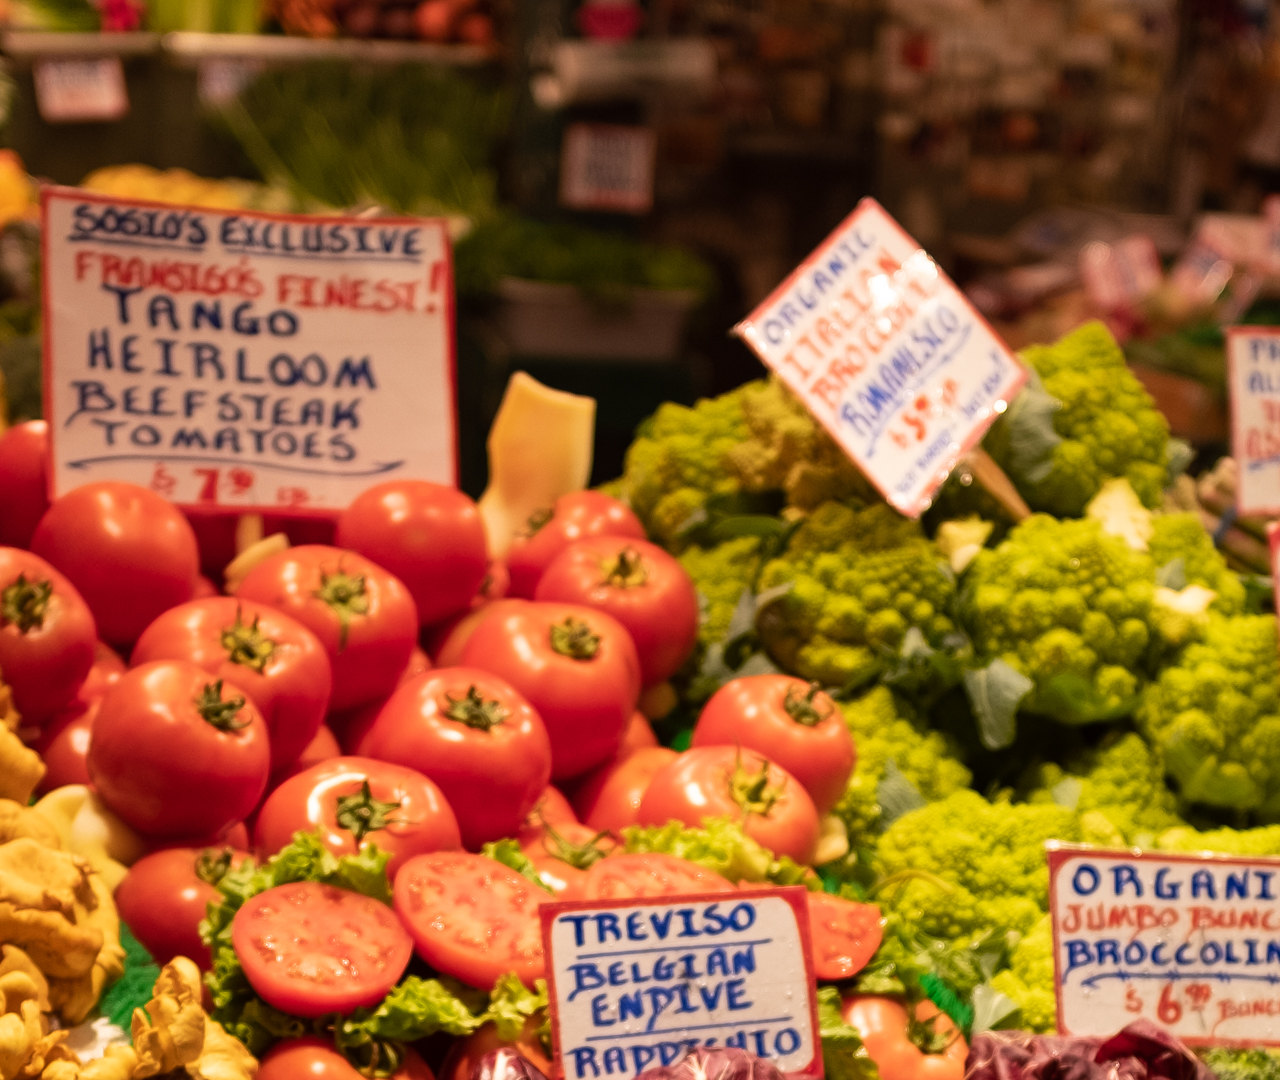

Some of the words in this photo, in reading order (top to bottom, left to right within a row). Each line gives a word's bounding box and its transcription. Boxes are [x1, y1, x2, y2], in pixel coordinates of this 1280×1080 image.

[220, 216, 424, 257] EXCLUSIVE
[100, 283, 300, 337] TANGO
[276, 259, 449, 317] FINEST!
[87, 328, 377, 389] HEIRLOOM
[64, 380, 361, 430] BEEFSTEAK
[92, 417, 358, 463] TOMATOES
[558, 902, 757, 947] TREVISO
[1061, 903, 1181, 942] JUMBO
[566, 943, 757, 1002] BELGIAN
[590, 978, 754, 1034] ENDIVE
